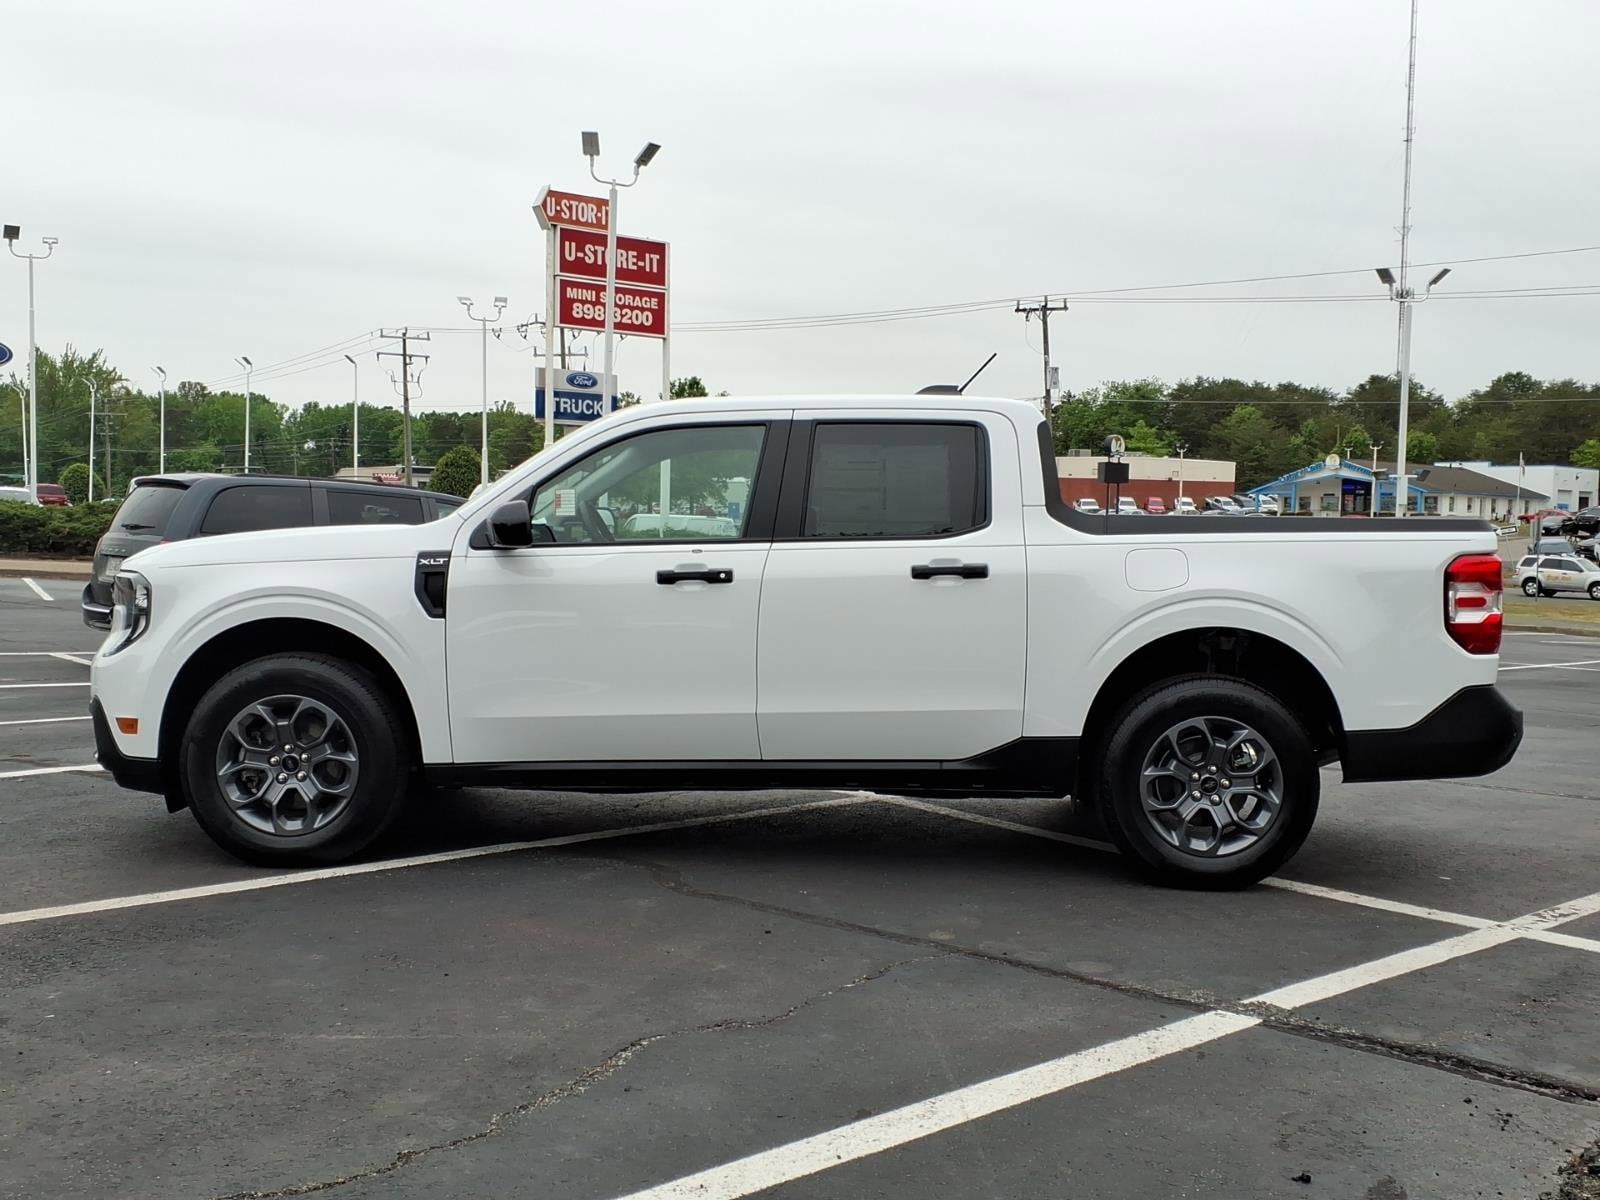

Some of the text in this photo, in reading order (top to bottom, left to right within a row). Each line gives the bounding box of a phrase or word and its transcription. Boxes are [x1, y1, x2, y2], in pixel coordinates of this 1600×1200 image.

[566, 287, 659, 309] MINI SORAGE
[572, 302, 653, 326] 8983200
[574, 376, 593, 387] Ford
